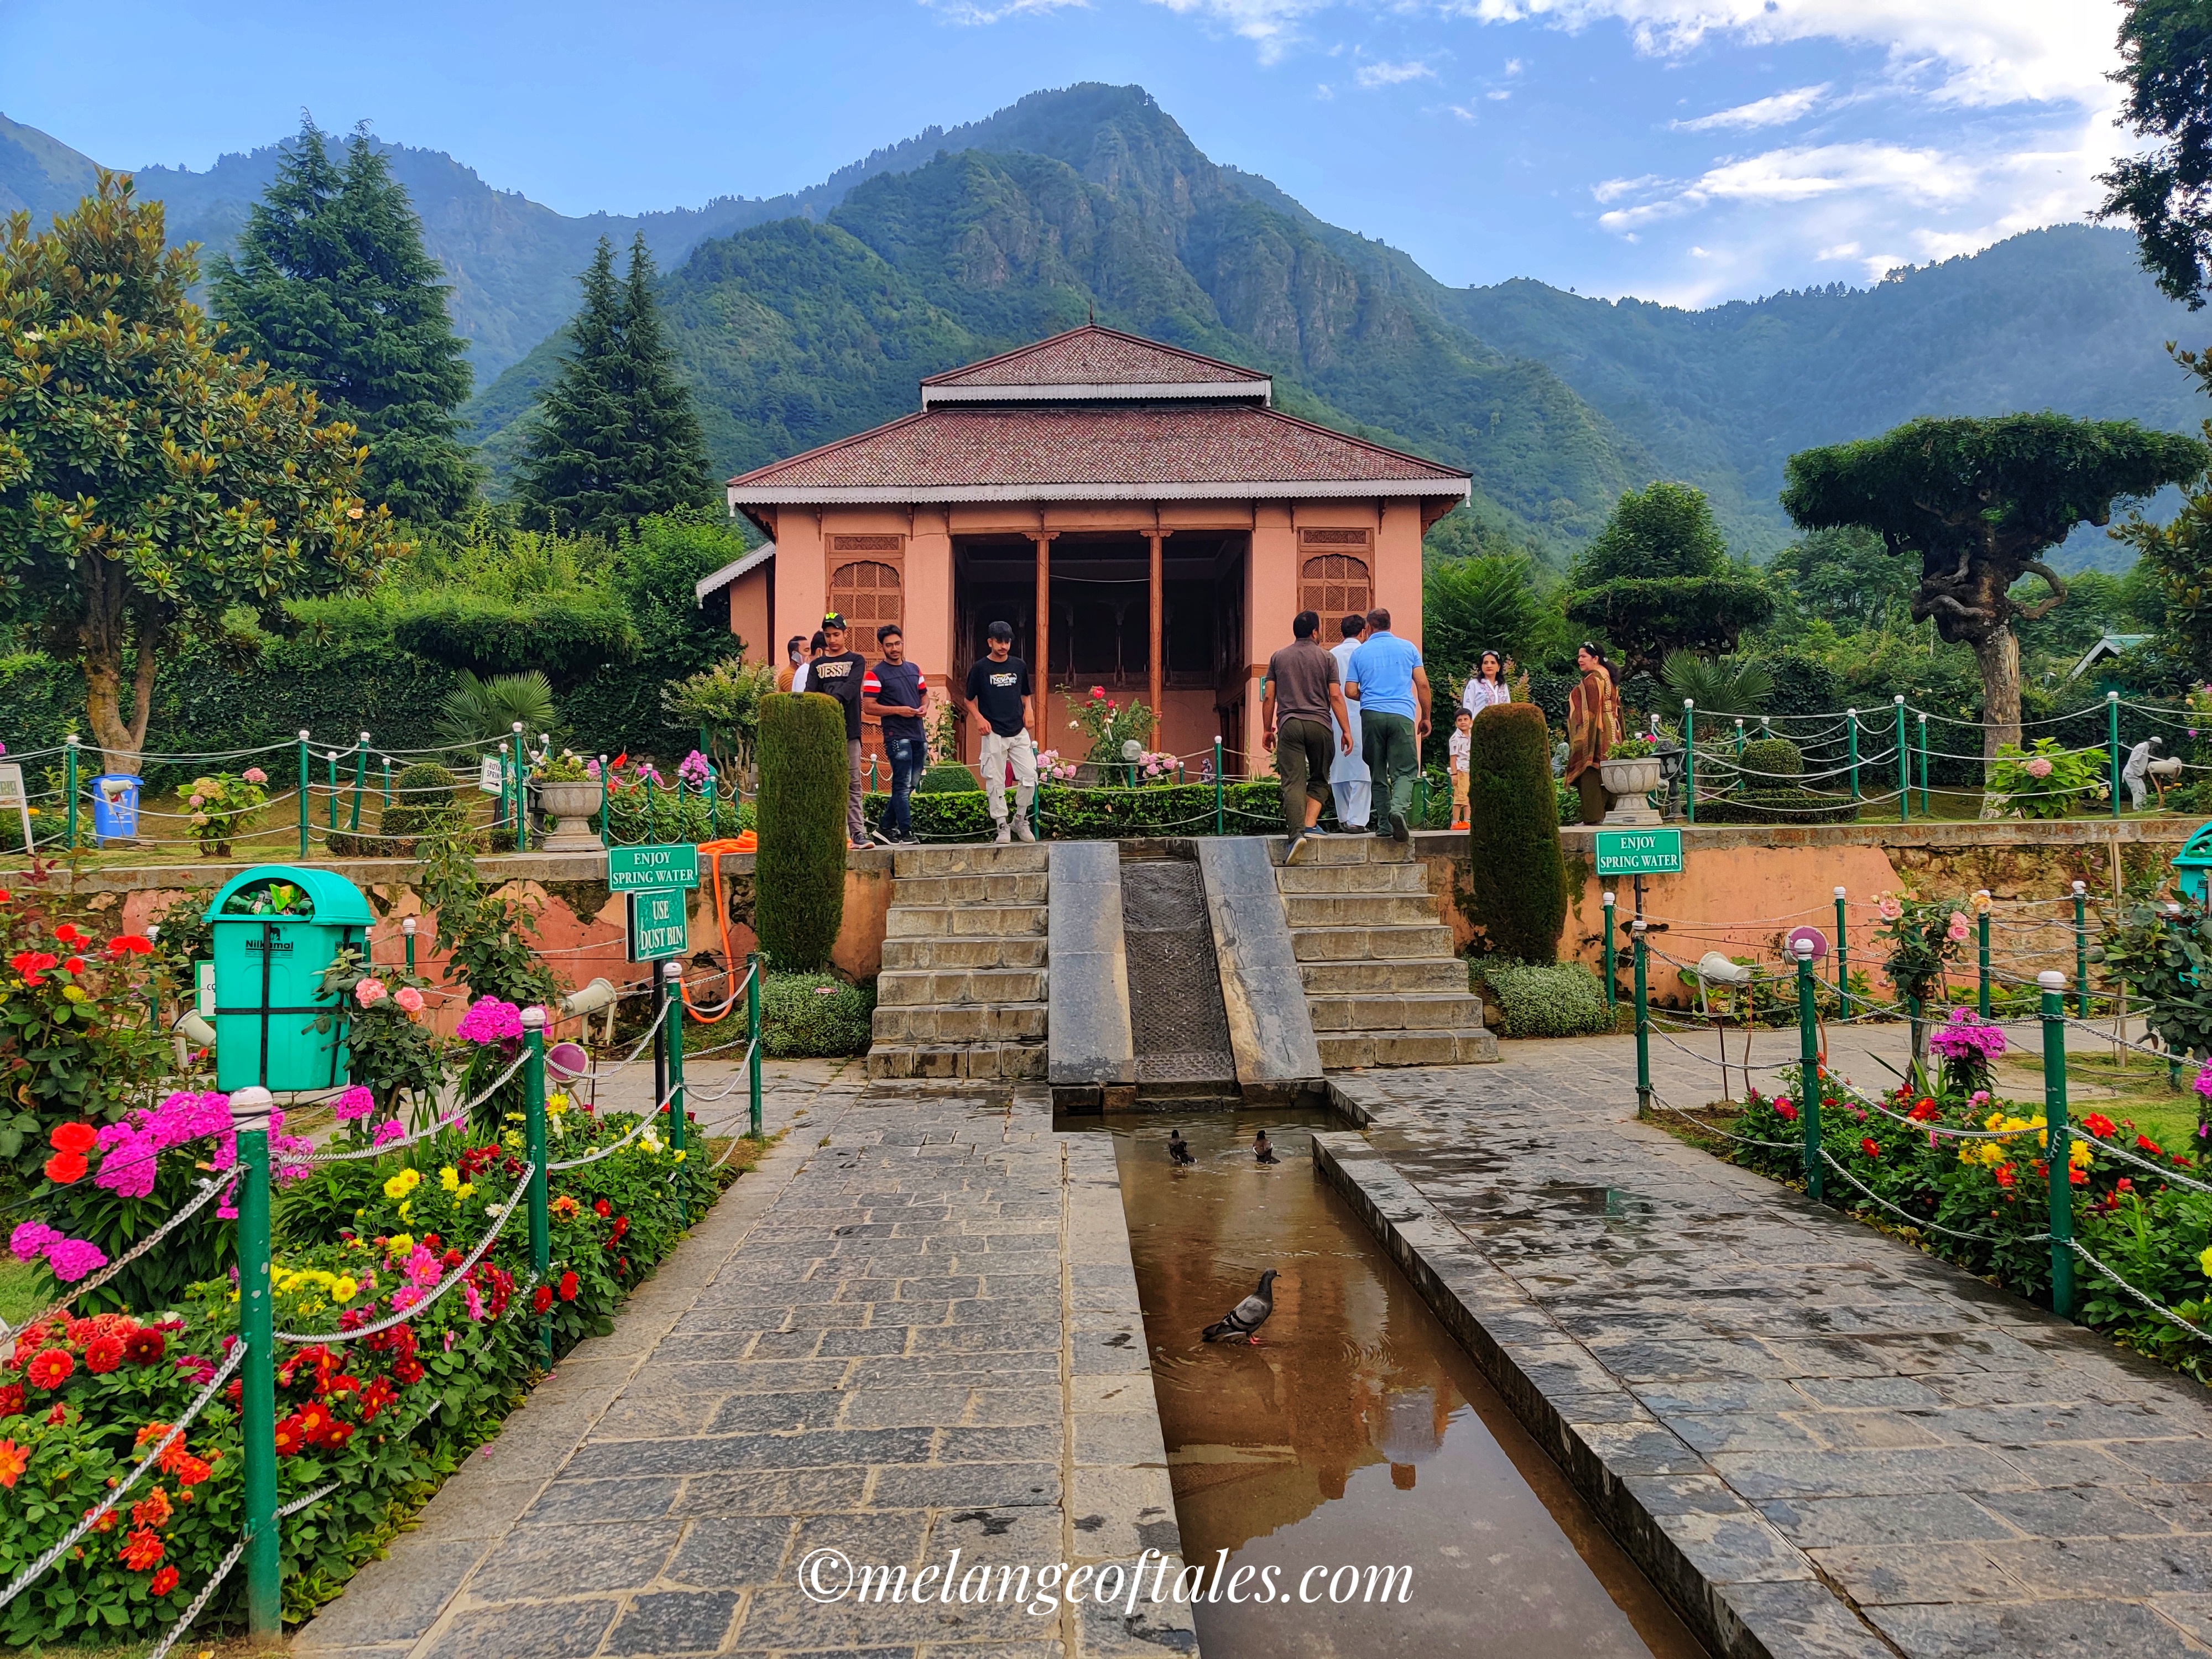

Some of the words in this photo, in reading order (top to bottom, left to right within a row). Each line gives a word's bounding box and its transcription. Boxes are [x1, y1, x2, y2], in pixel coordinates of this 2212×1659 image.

[487, 770, 502, 780] SPRIN
[489, 763, 501, 772] ROYA
[1620, 836, 1656, 851] ENJOY
[634, 852, 671, 867] ENJOY
[1600, 855, 1639, 868] SPRING
[1641, 854, 1678, 867] WATER
[613, 871, 654, 885] SPRING
[655, 869, 695, 883] WATER
[652, 900, 670, 920] USE
[640, 927, 665, 950] DUST
[666, 925, 684, 946] BIN
